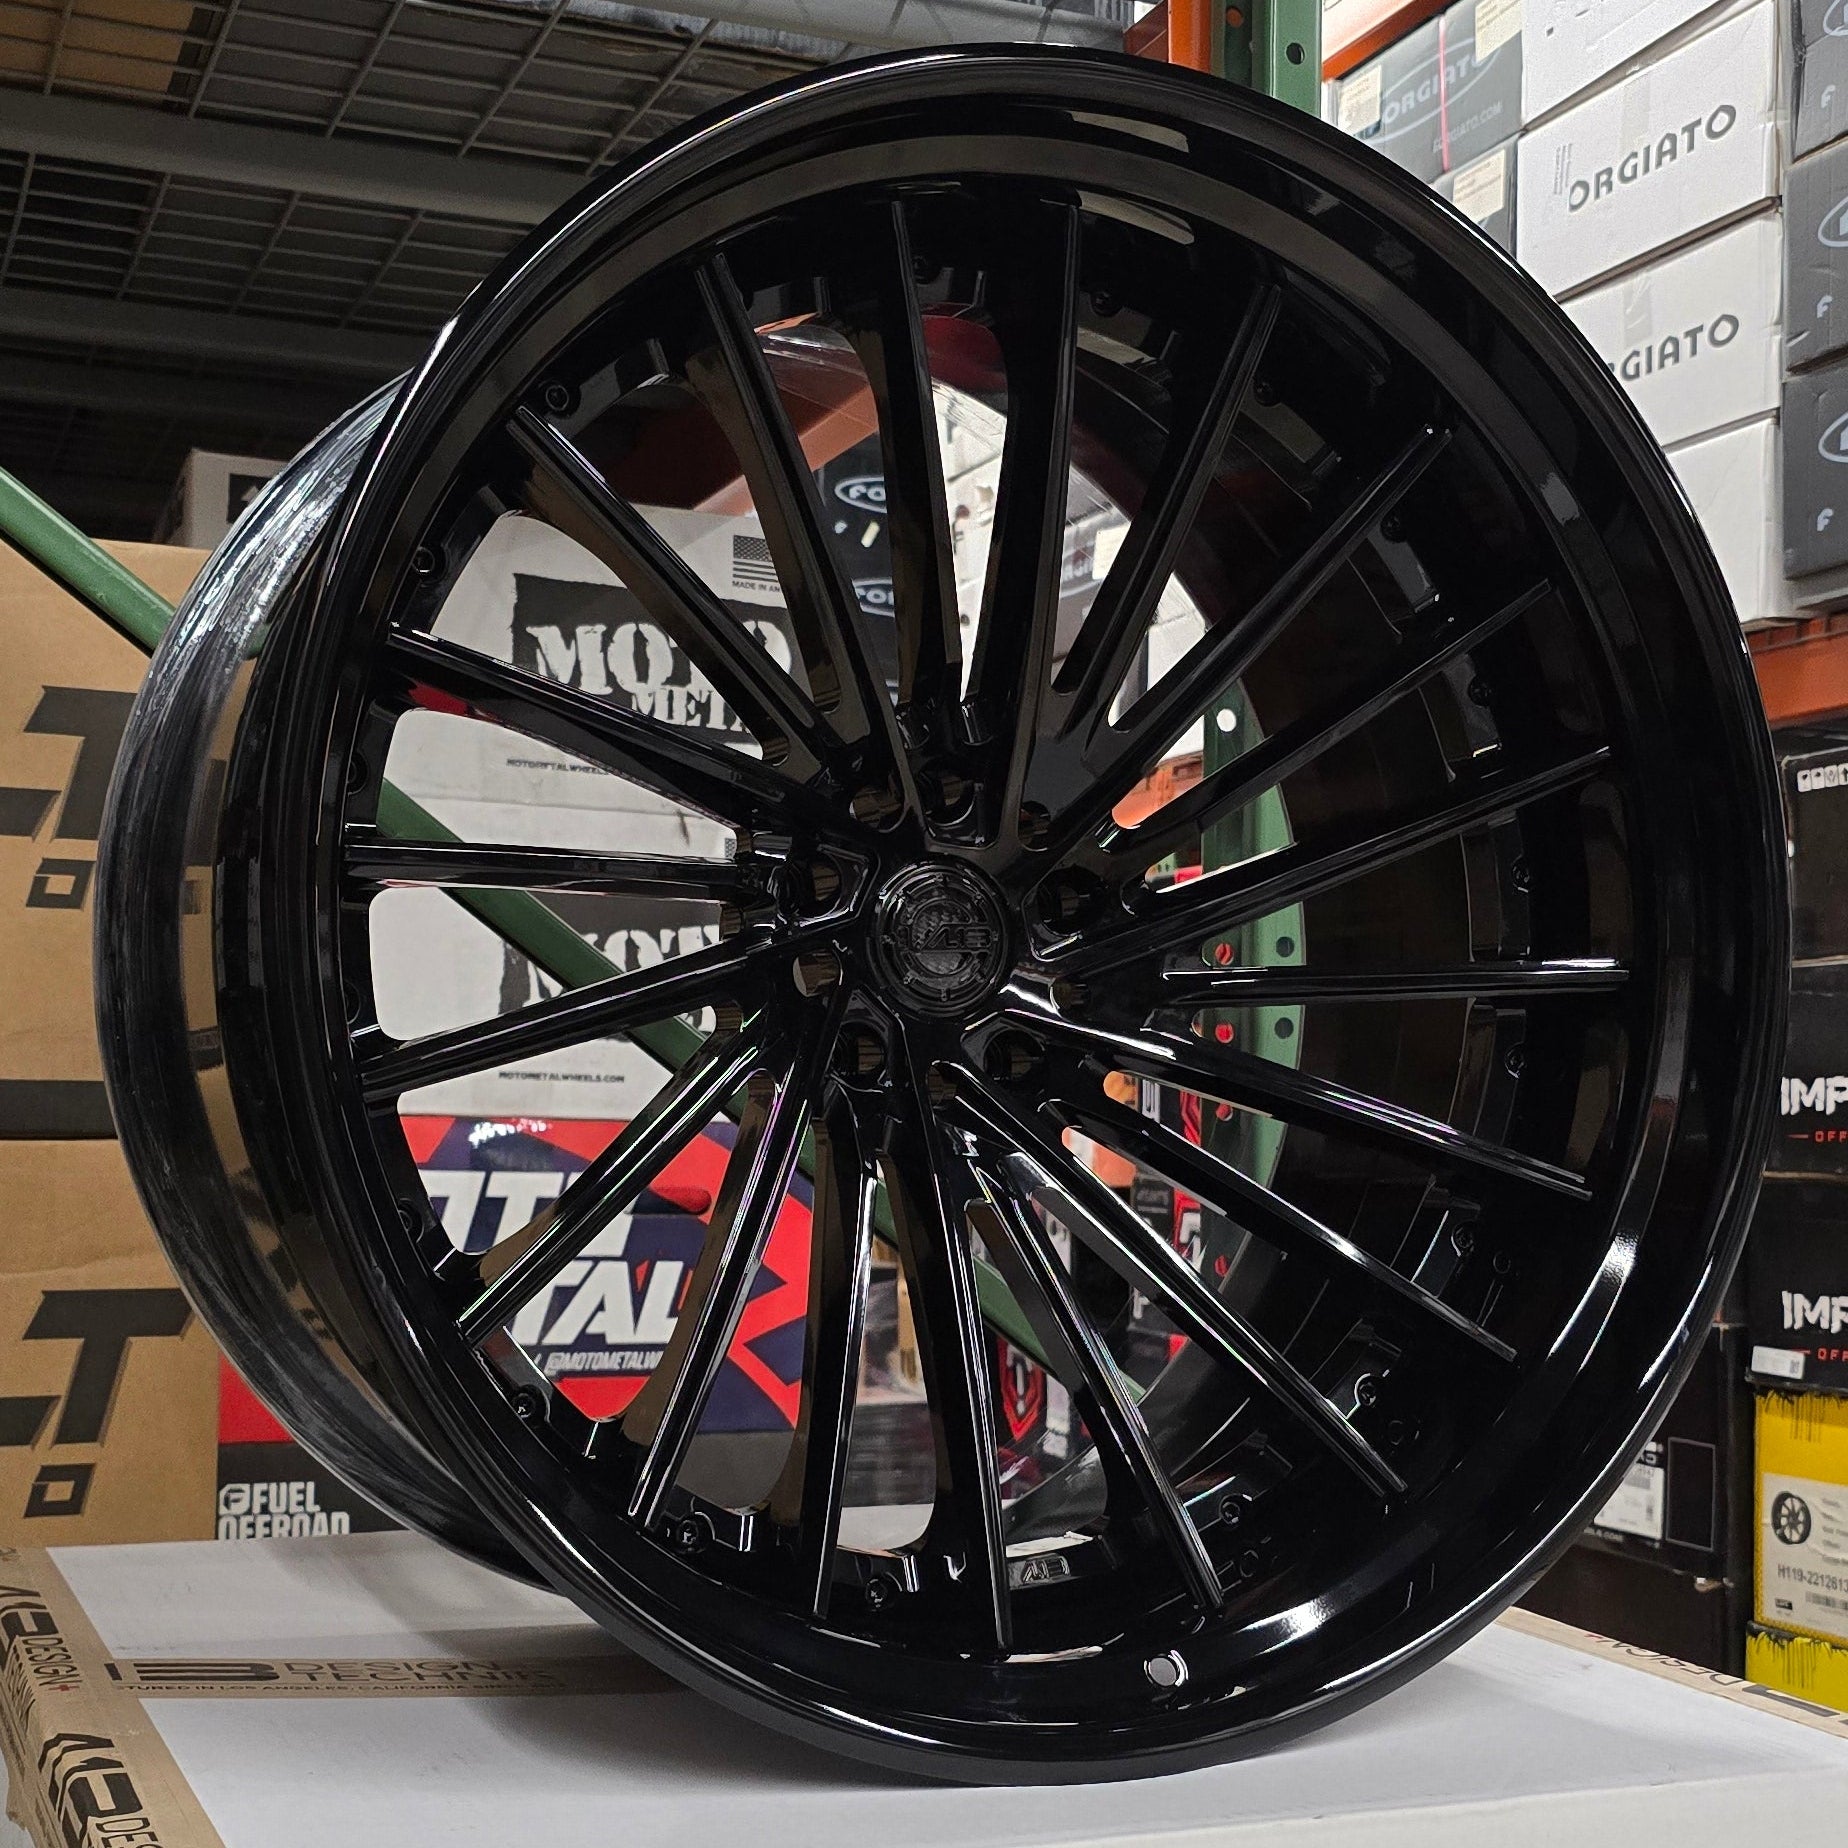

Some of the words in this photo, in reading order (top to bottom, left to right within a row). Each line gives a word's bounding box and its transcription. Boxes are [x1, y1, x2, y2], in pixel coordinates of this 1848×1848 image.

[1608, 313, 1740, 383] GIATO
[732, 580, 756, 590] MADE
[758, 583, 767, 592] IN
[631, 683, 752, 733] MET
[251, 1481, 321, 1514] FUEL
